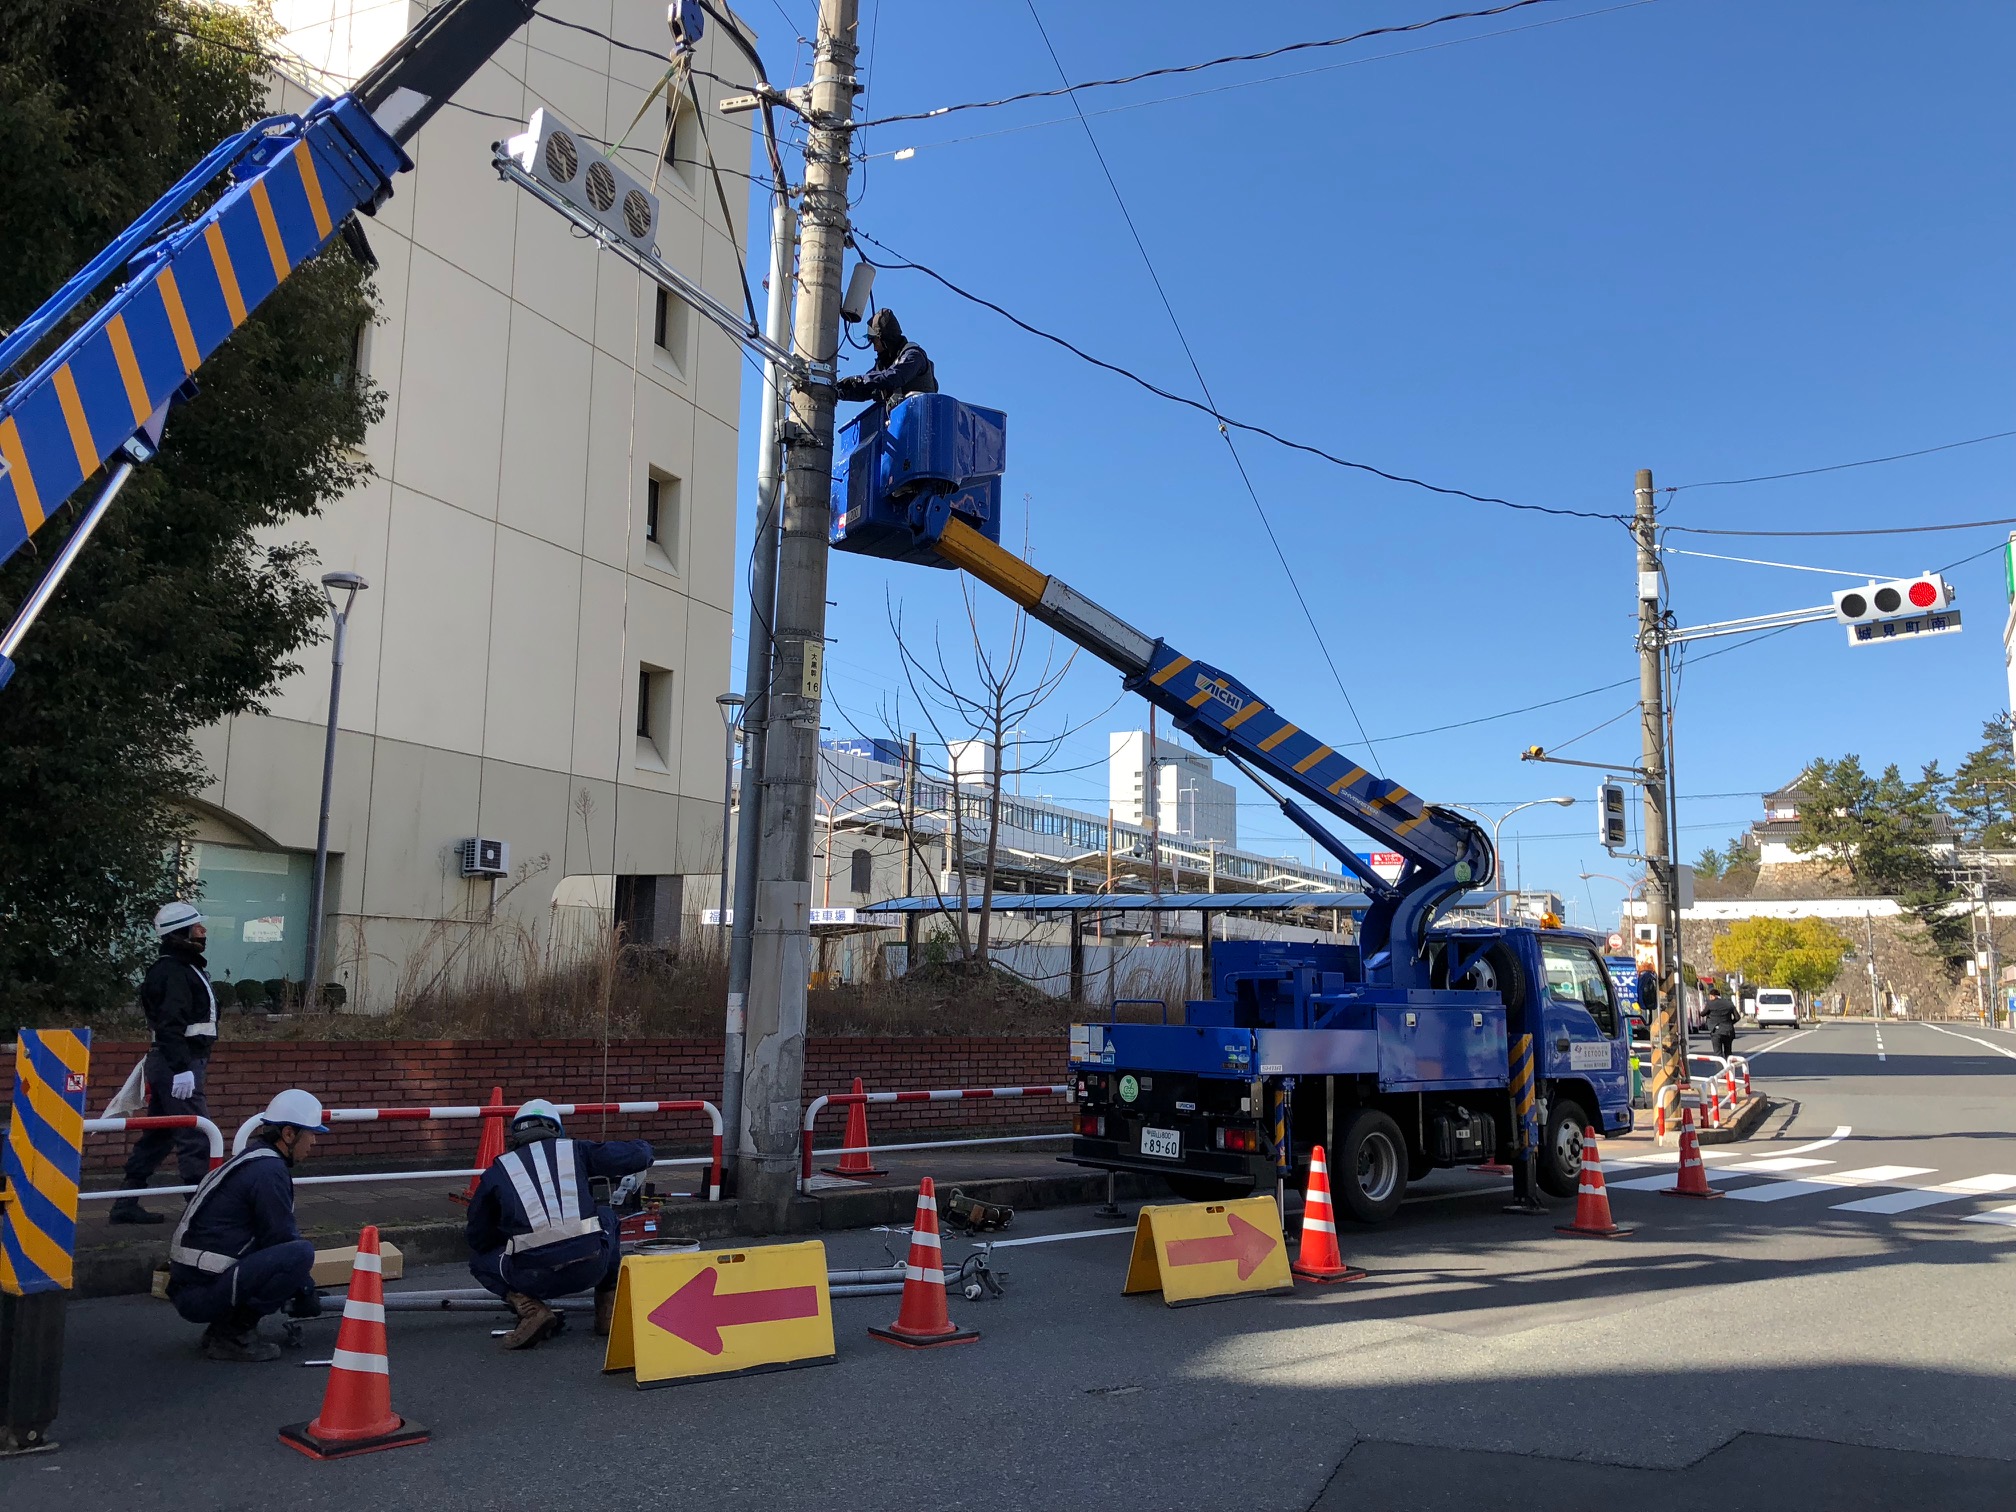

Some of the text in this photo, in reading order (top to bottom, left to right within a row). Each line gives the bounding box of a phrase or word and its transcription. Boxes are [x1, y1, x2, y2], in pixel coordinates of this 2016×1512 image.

[1858, 615, 1951, 641] 城見町(南)
[806, 681, 819, 693] 16
[1203, 682, 1240, 710] AICHI
[1149, 1139, 1177, 1155] 89-60
